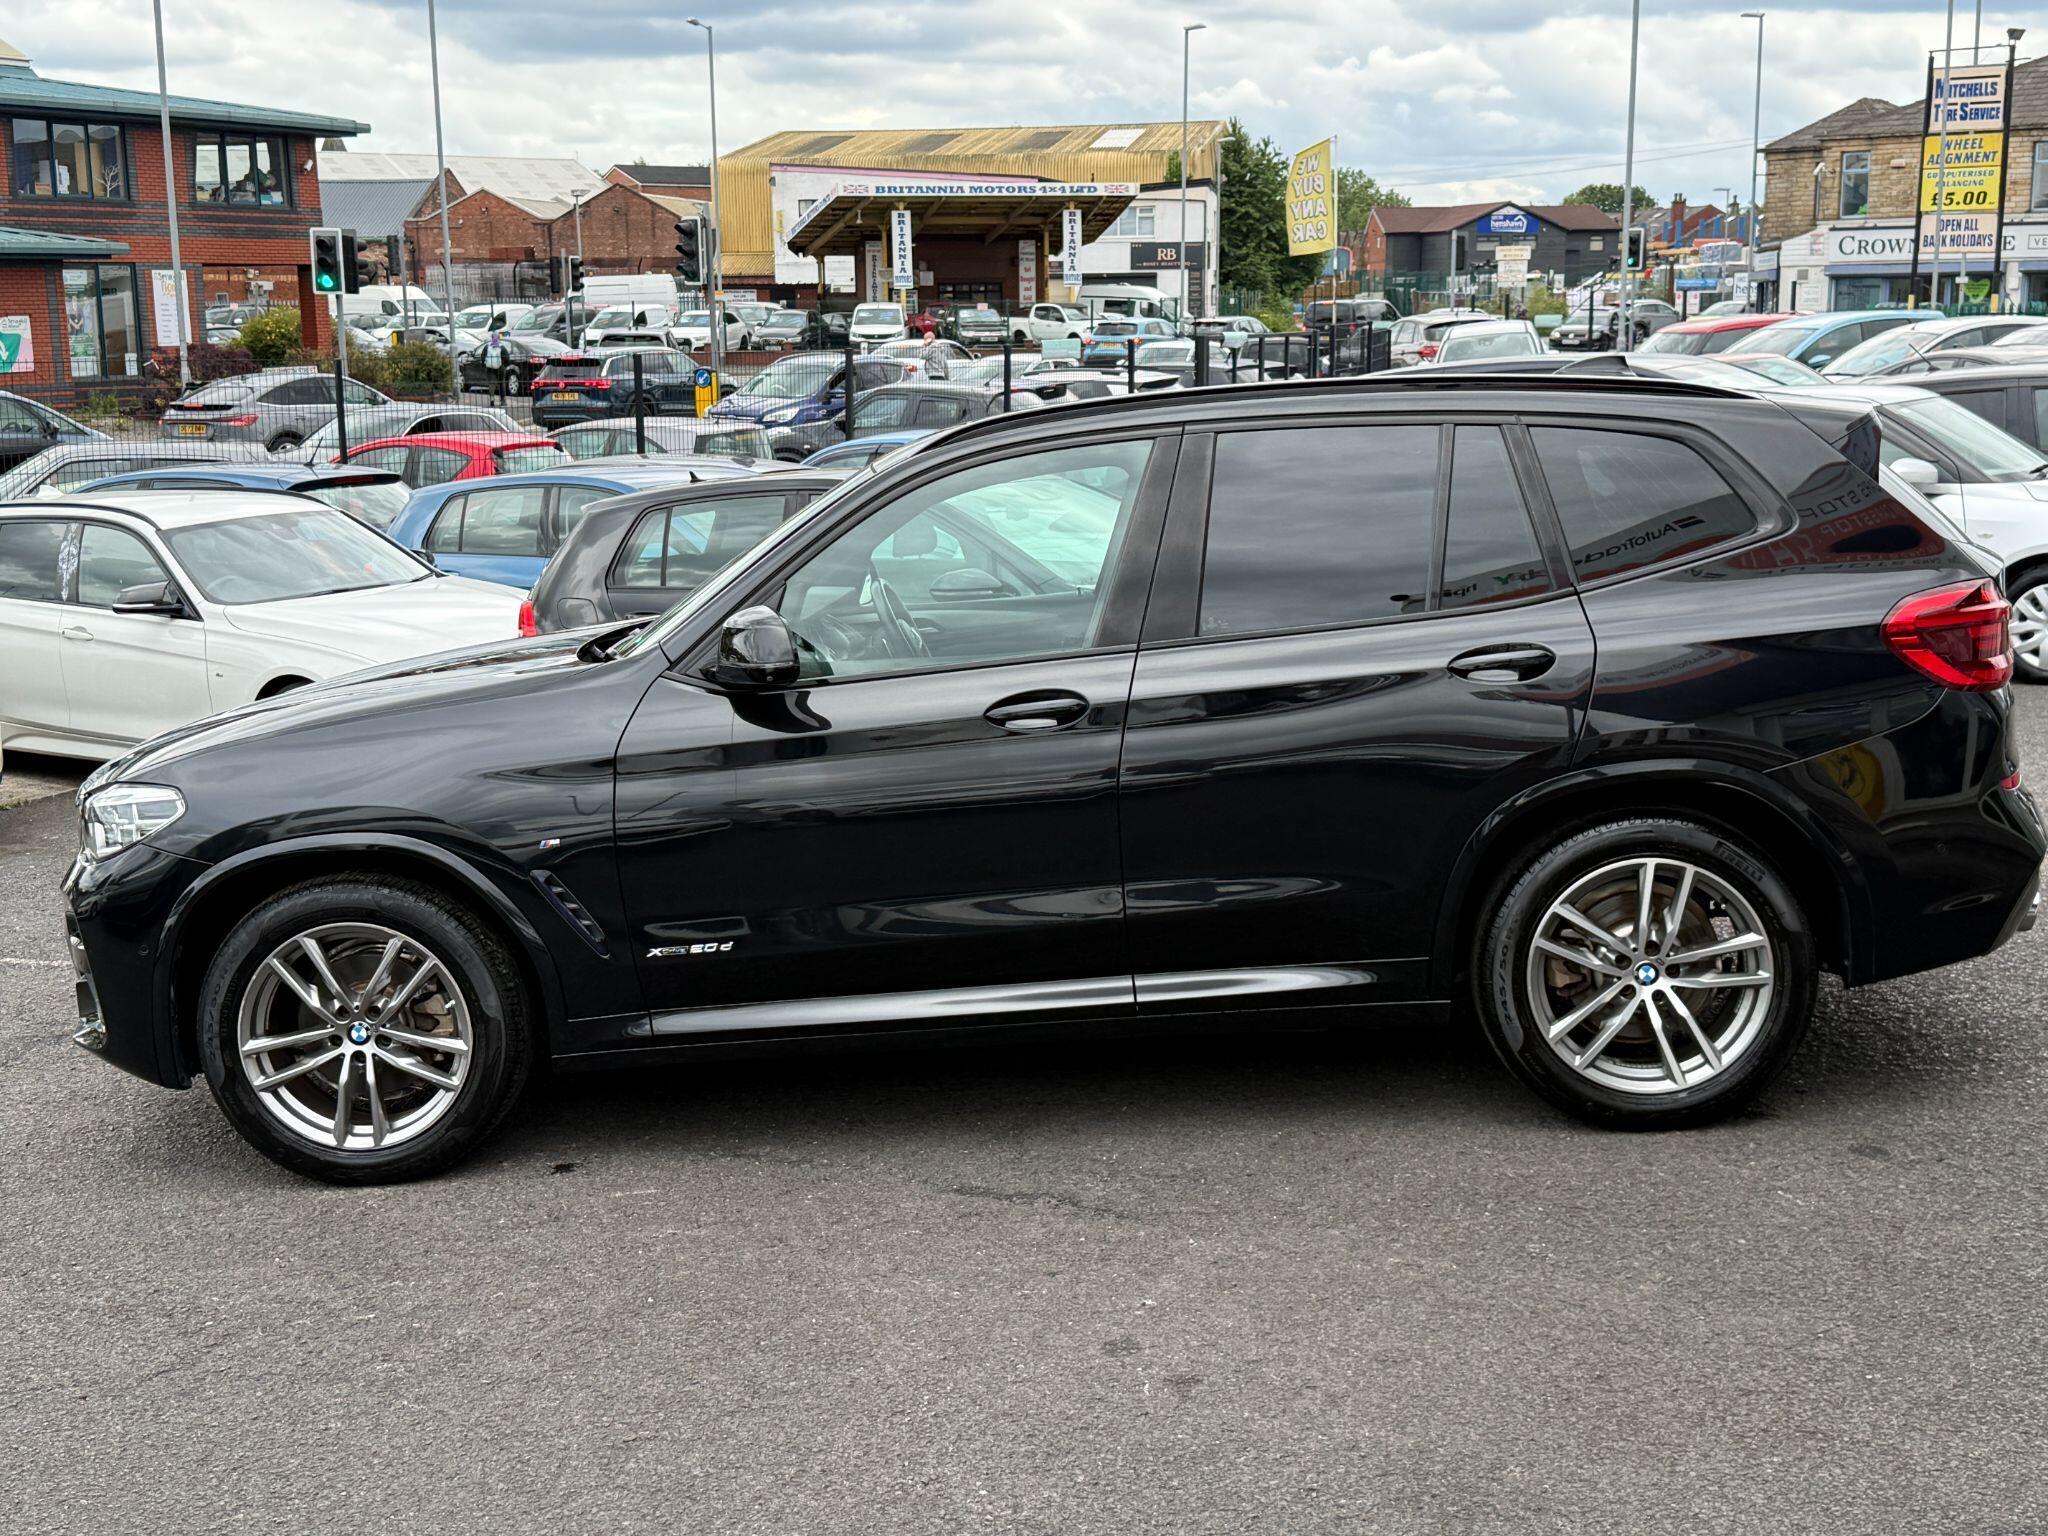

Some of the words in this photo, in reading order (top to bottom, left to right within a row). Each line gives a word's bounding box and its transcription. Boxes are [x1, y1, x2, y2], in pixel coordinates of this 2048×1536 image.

[1934, 78, 1998, 99] MITCHELLS
[1934, 103, 1958, 122] TRE
[1959, 102, 2000, 121] SERVICE
[1927, 150, 1998, 166] ALGNMENT
[875, 185, 966, 194] BRITANNIA
[969, 185, 1037, 194] MOTORS
[1069, 185, 1099, 194] LTD
[1931, 190, 1988, 206] £5.00
[1939, 218, 1962, 232] OPEN
[1963, 218, 1979, 232] ALL
[897, 212, 907, 274] BRITANNIA
[1068, 211, 1077, 272] BRITANNIA
[1922, 234, 1950, 248] BAK
[1950, 233, 1994, 248] HOLIDAYS
[1157, 248, 1177, 261] RB
